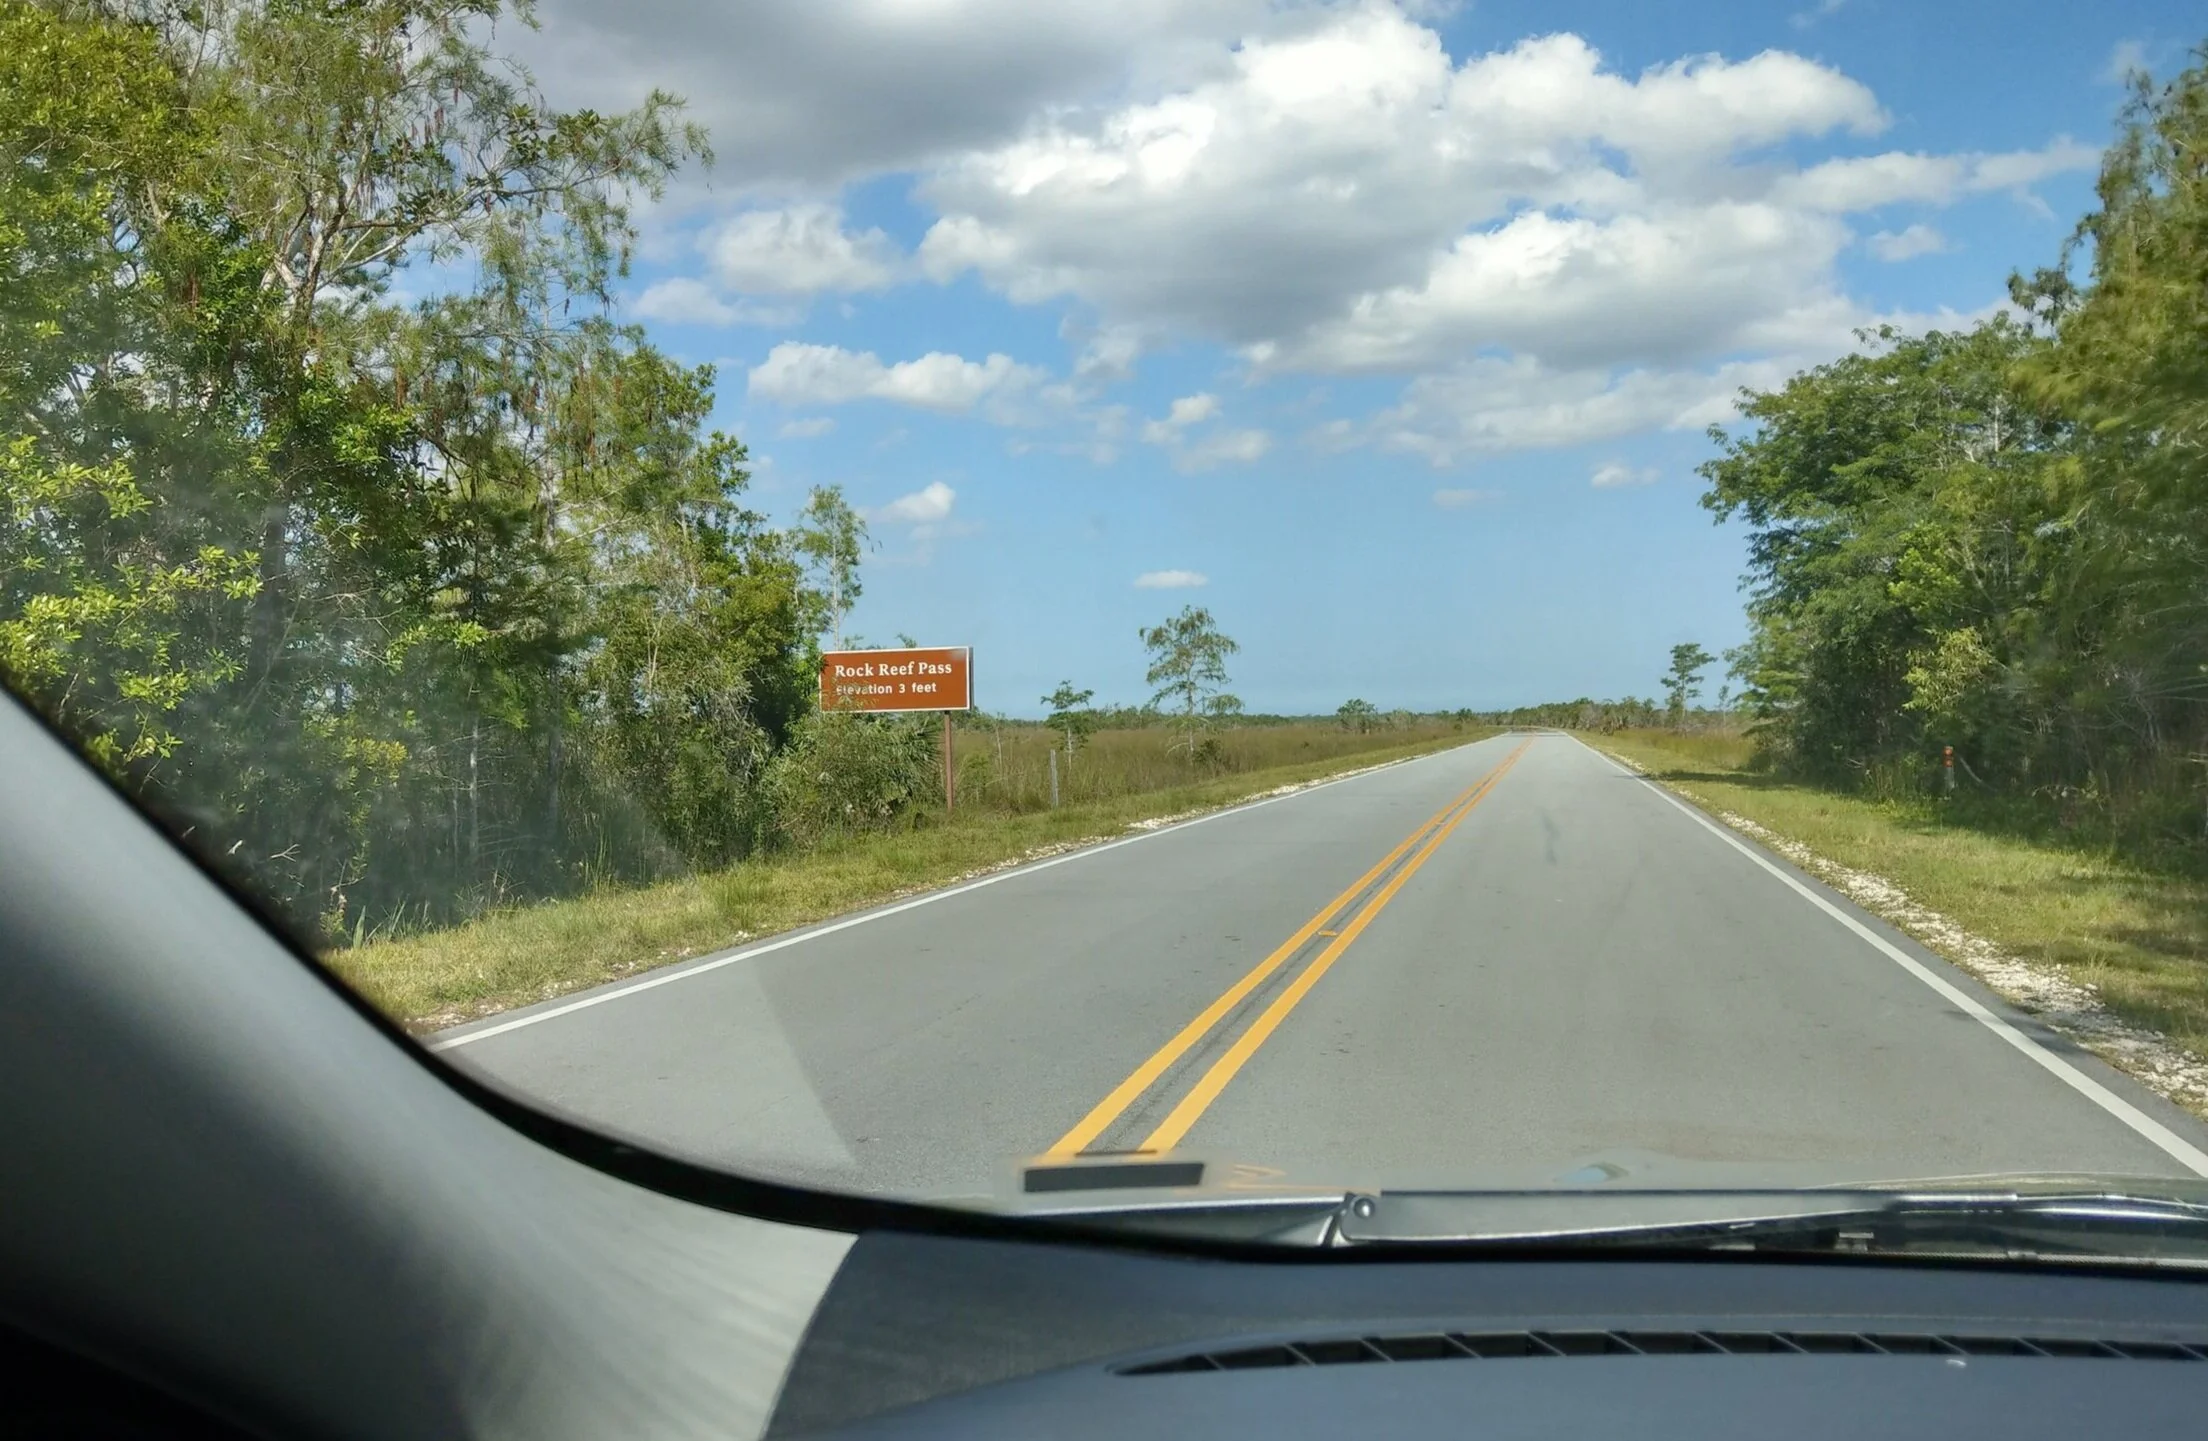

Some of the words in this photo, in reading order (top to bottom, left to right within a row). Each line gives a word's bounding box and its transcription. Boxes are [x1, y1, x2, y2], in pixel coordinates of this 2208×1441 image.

[835, 663, 874, 677] Rock
[879, 661, 915, 676] Reef
[918, 662, 952, 675] Pass
[898, 685, 906, 694] 3
[911, 682, 937, 693] feet
